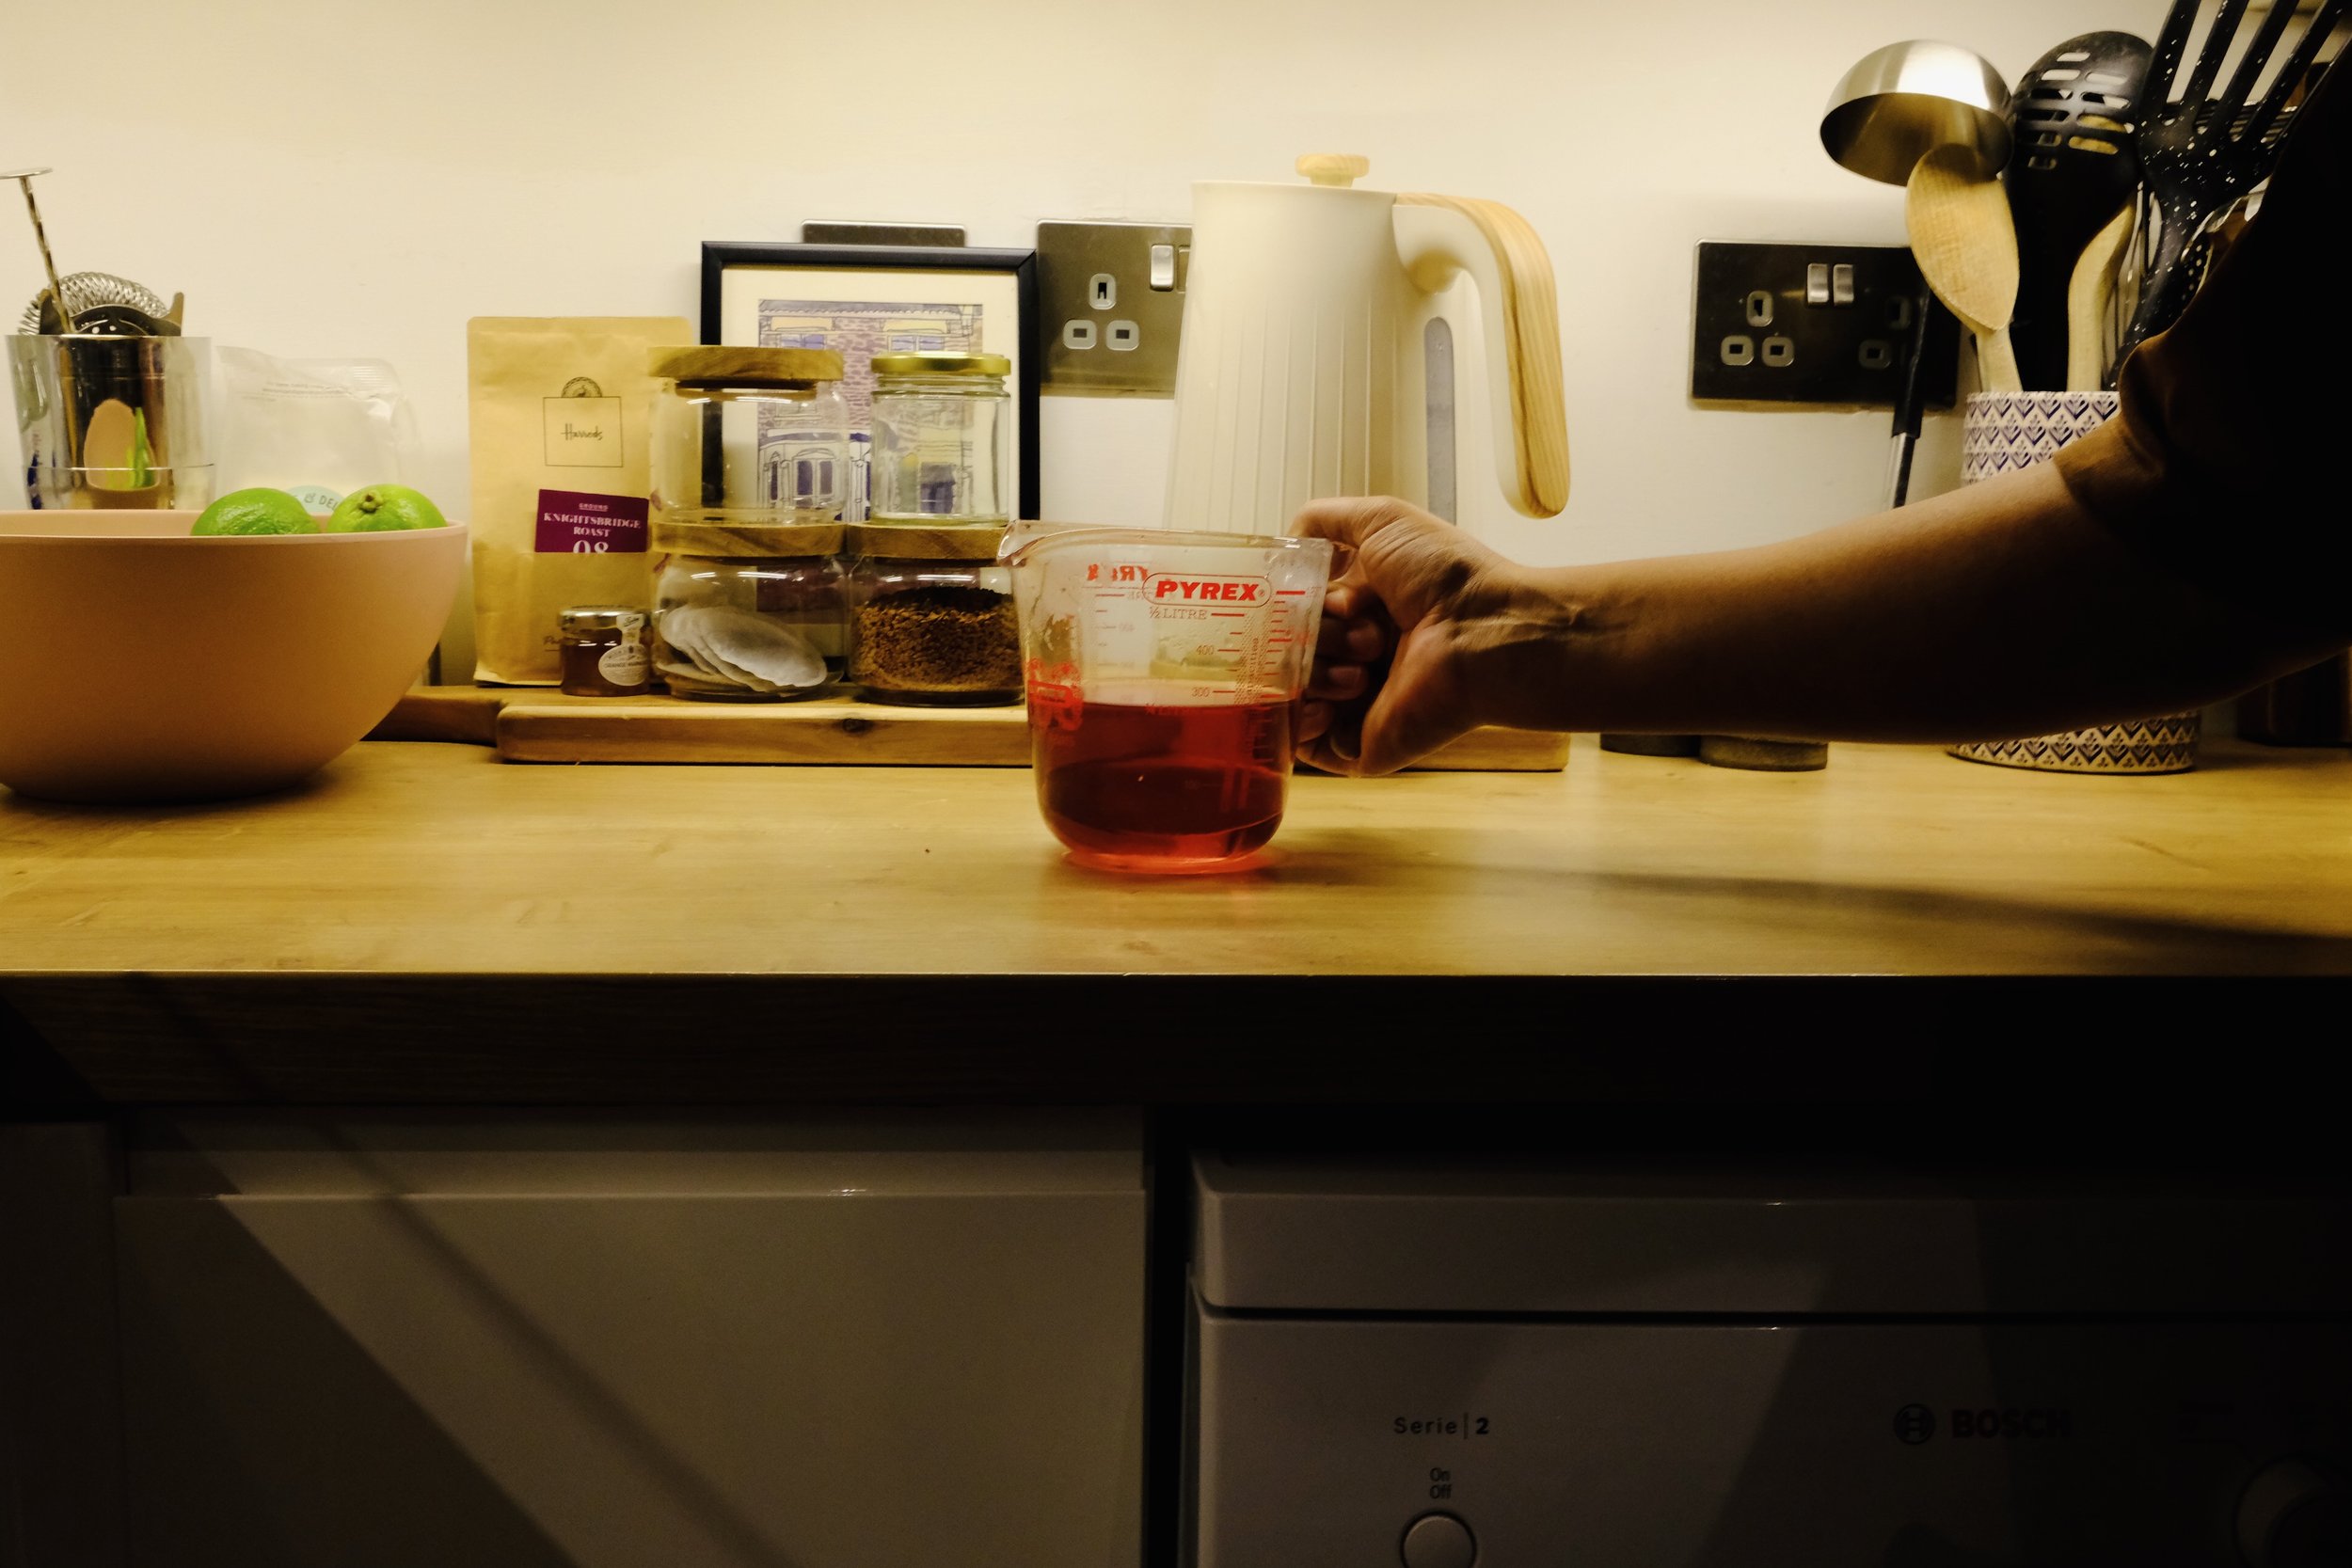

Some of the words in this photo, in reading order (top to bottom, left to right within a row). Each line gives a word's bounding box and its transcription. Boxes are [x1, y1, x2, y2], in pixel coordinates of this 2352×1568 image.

[561, 422, 603, 441] Harrods
[544, 512, 642, 529] KNIGHTSBRIDGE
[573, 526, 612, 537] ROAST
[1155, 580, 1260, 601] PYREX
[1163, 608, 1208, 620] LITRE
[1196, 645, 1216, 656] 400
[1191, 687, 1211, 697] 300
[1393, 1417, 1457, 1434] Serie
[1951, 1408, 2073, 1439] BOSCH
[1429, 1466, 1451, 1481] On
[1429, 1483, 1453, 1499] Off
